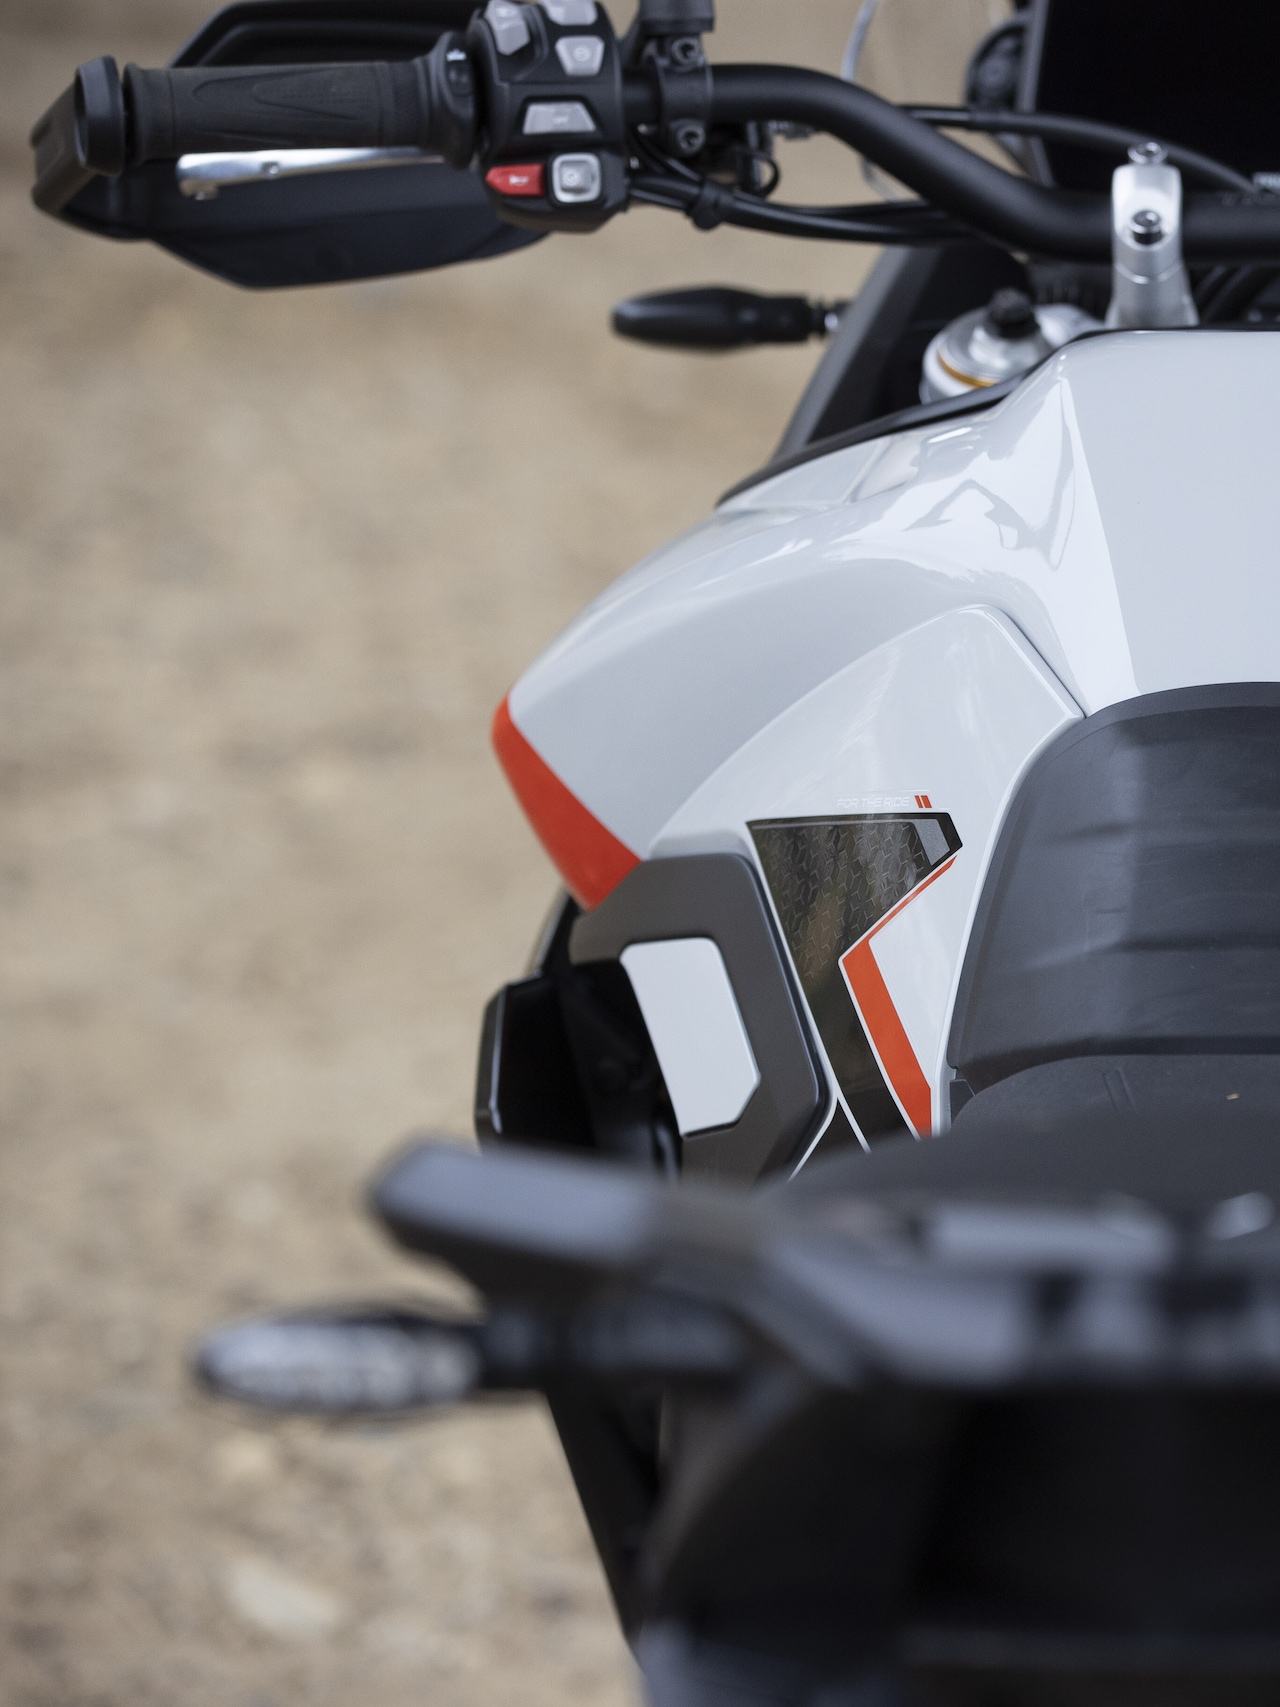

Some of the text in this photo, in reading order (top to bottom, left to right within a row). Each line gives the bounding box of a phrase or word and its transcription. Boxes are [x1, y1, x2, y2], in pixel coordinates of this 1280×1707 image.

[837, 796, 910, 809] FOR THE RIDE
